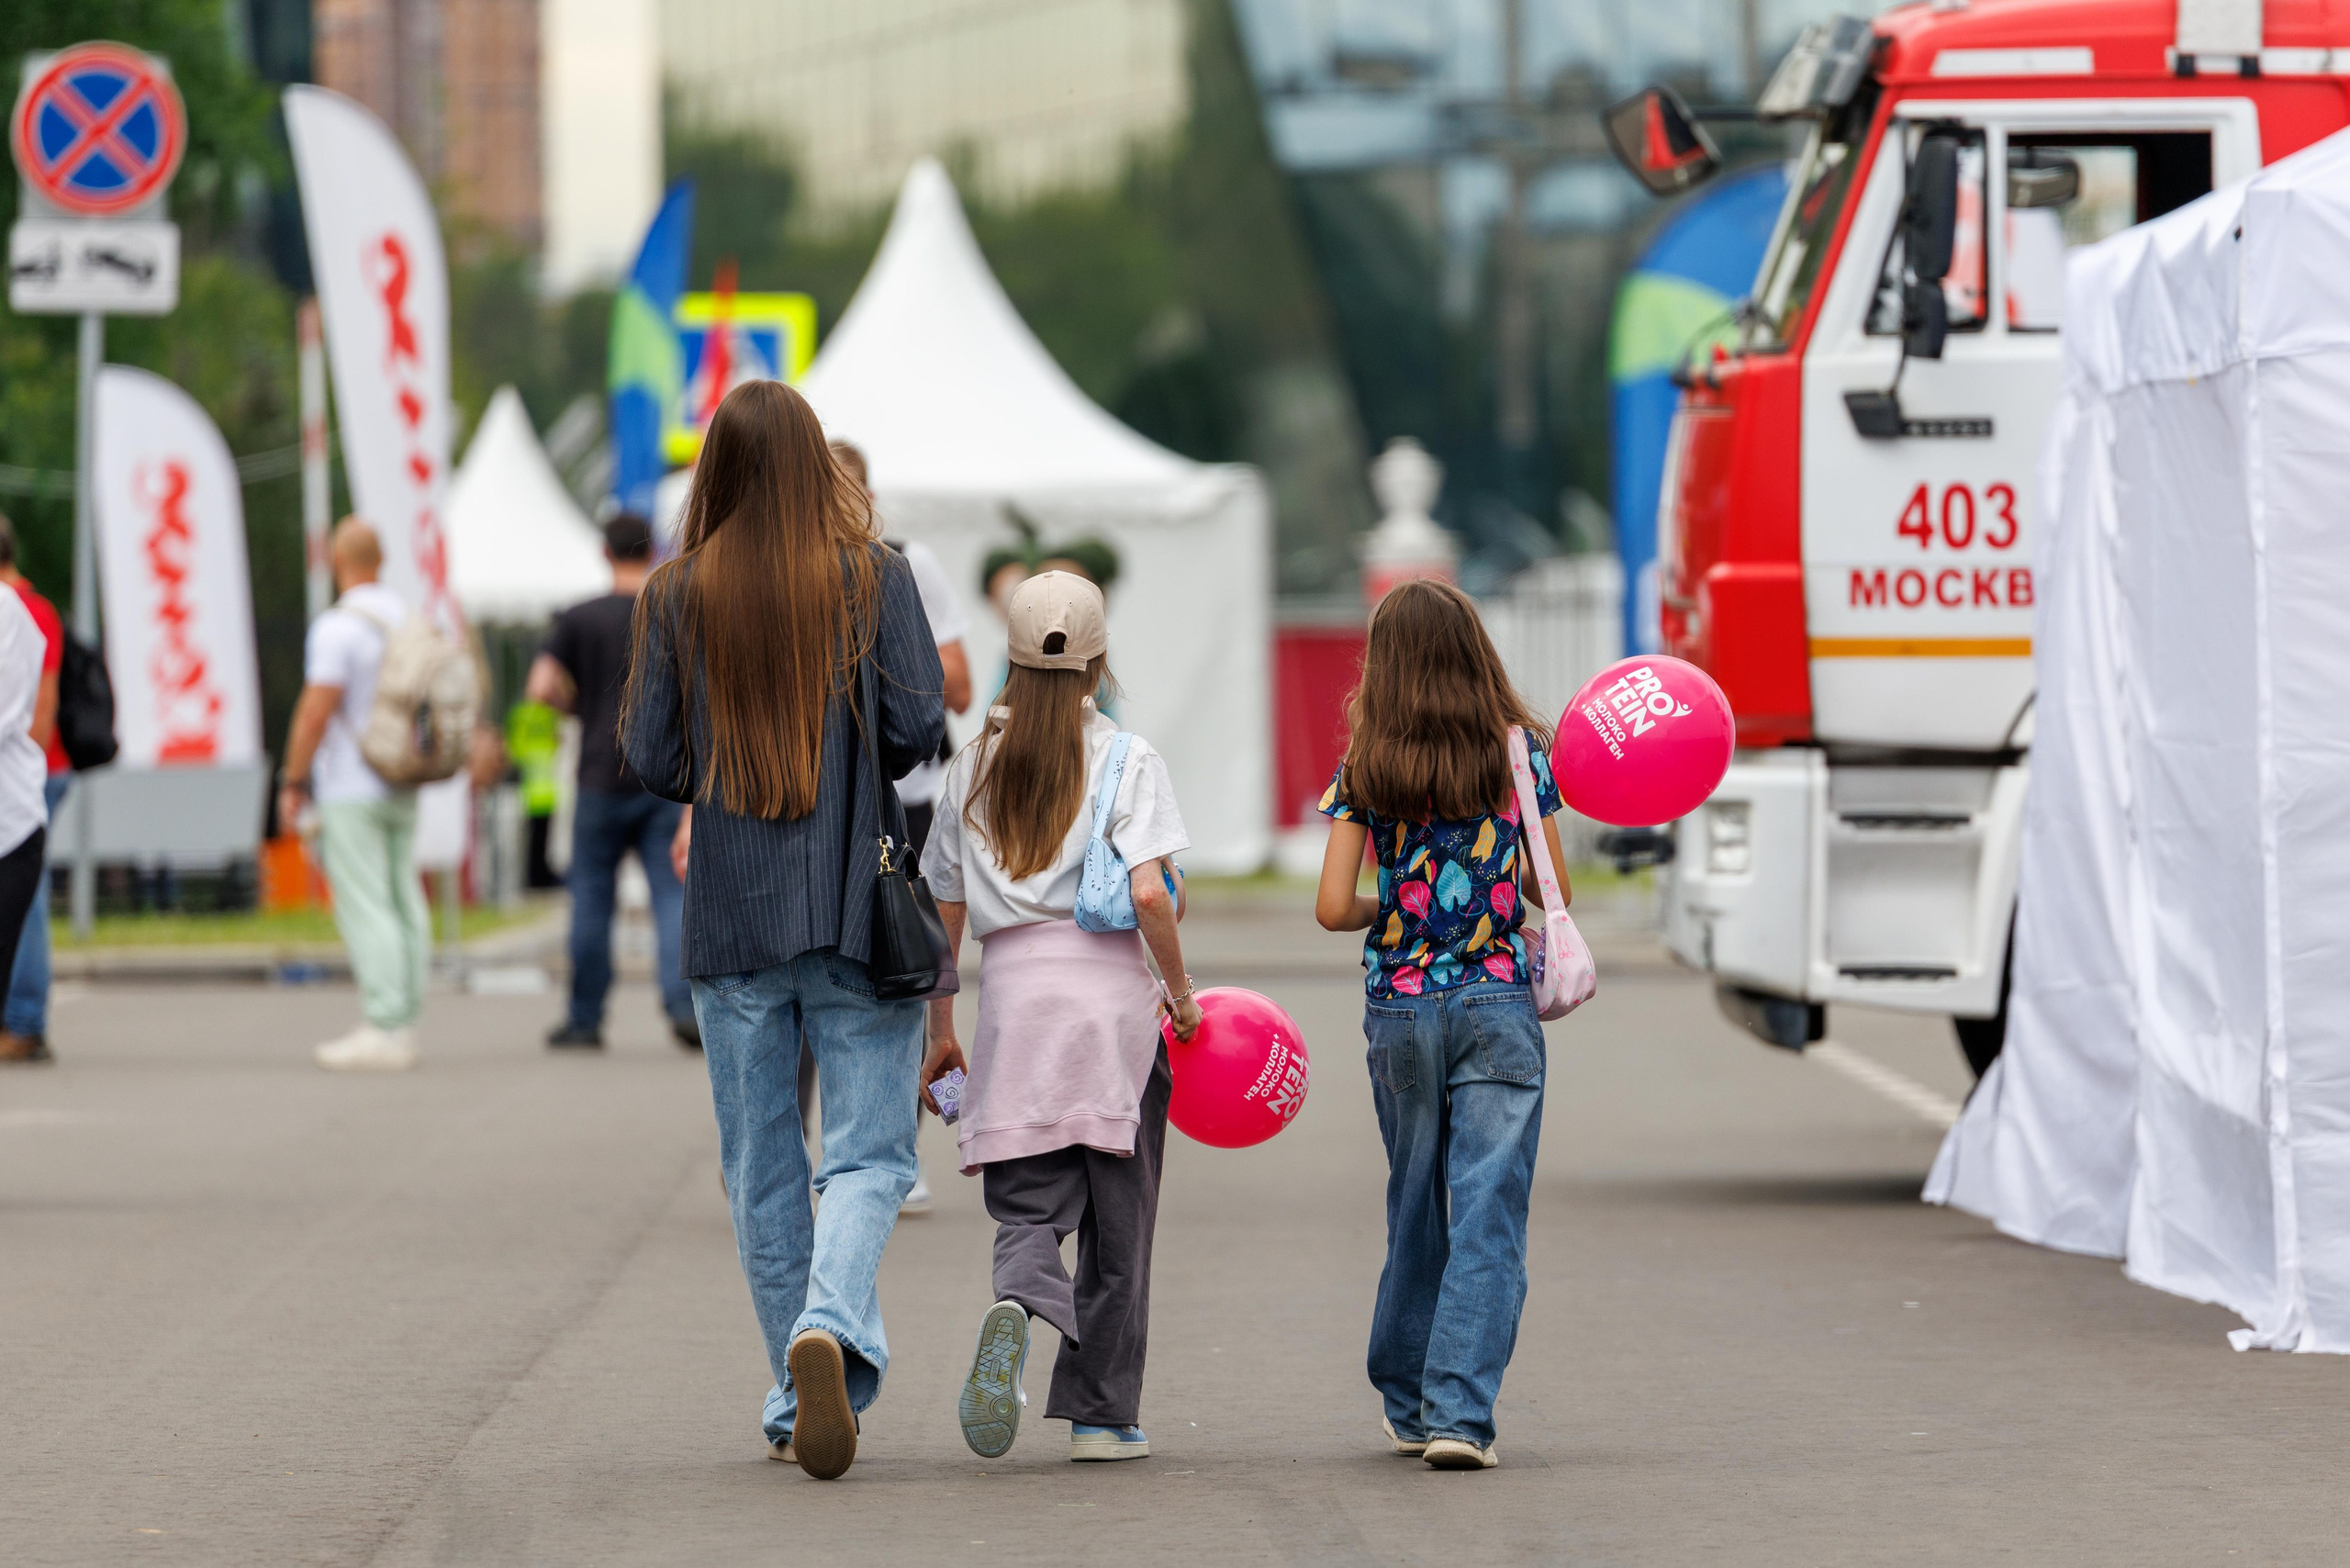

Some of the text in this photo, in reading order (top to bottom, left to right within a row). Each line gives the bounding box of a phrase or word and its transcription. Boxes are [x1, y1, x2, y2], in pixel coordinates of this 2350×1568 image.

[1897, 481, 2019, 551] 403
[1850, 567, 2034, 608] МОСКВ
[1604, 678, 1656, 738] TEIN
[1626, 666, 1674, 716] PRO
[1583, 706, 1625, 761] КОЛЛАГЕН
[1592, 698, 1627, 743] МОЛОКО
[1243, 1041, 1281, 1101] КОЛЛАГЕН
[1260, 1046, 1289, 1098] МОЛОКО
[1266, 1052, 1304, 1115] TEIN
[1283, 1059, 1311, 1119] PRO
